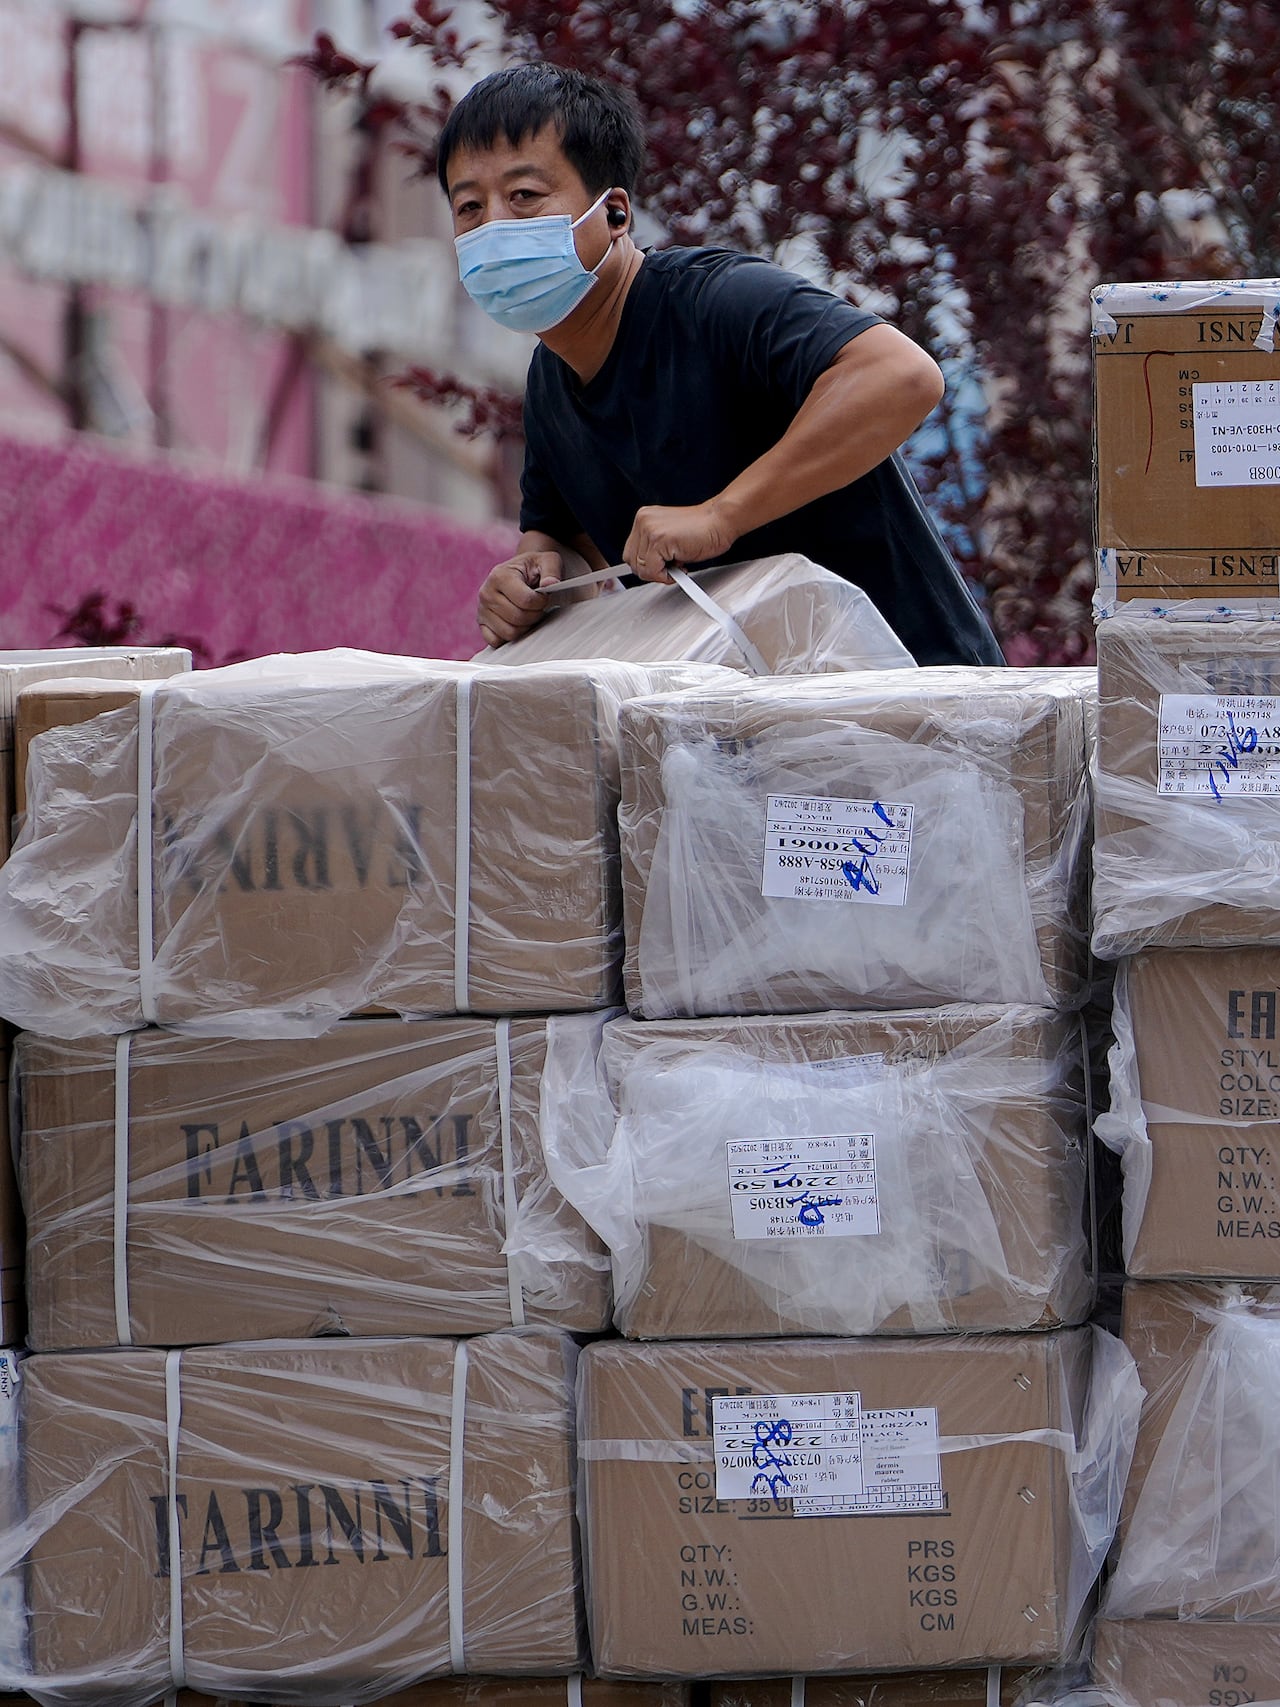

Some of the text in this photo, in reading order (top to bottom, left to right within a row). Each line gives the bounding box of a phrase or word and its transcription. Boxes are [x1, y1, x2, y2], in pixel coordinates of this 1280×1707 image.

[1179, 370, 1200, 380] CM
[778, 837, 871, 853] 220061
[1219, 1099, 1278, 1117] SIZE:
[179, 1114, 476, 1206] FARINNI
[1217, 1147, 1272, 1166] QTY:
[733, 1175, 838, 1190] 220159
[1217, 1172, 1275, 1189] N.W.:
[1217, 1196, 1275, 1213] G.W.:
[742, 1411, 779, 1419] BLACK
[678, 1496, 772, 1515] SIZE: 35
[149, 1476, 448, 1579] FARINNI
[680, 1541, 955, 1564] QTY: PRS
[680, 1565, 956, 1588] N.W.: KGS
[681, 1589, 958, 1612] G.W.: KGS
[682, 1613, 955, 1638] MEAS: CM
[1213, 1665, 1247, 1683] CM
